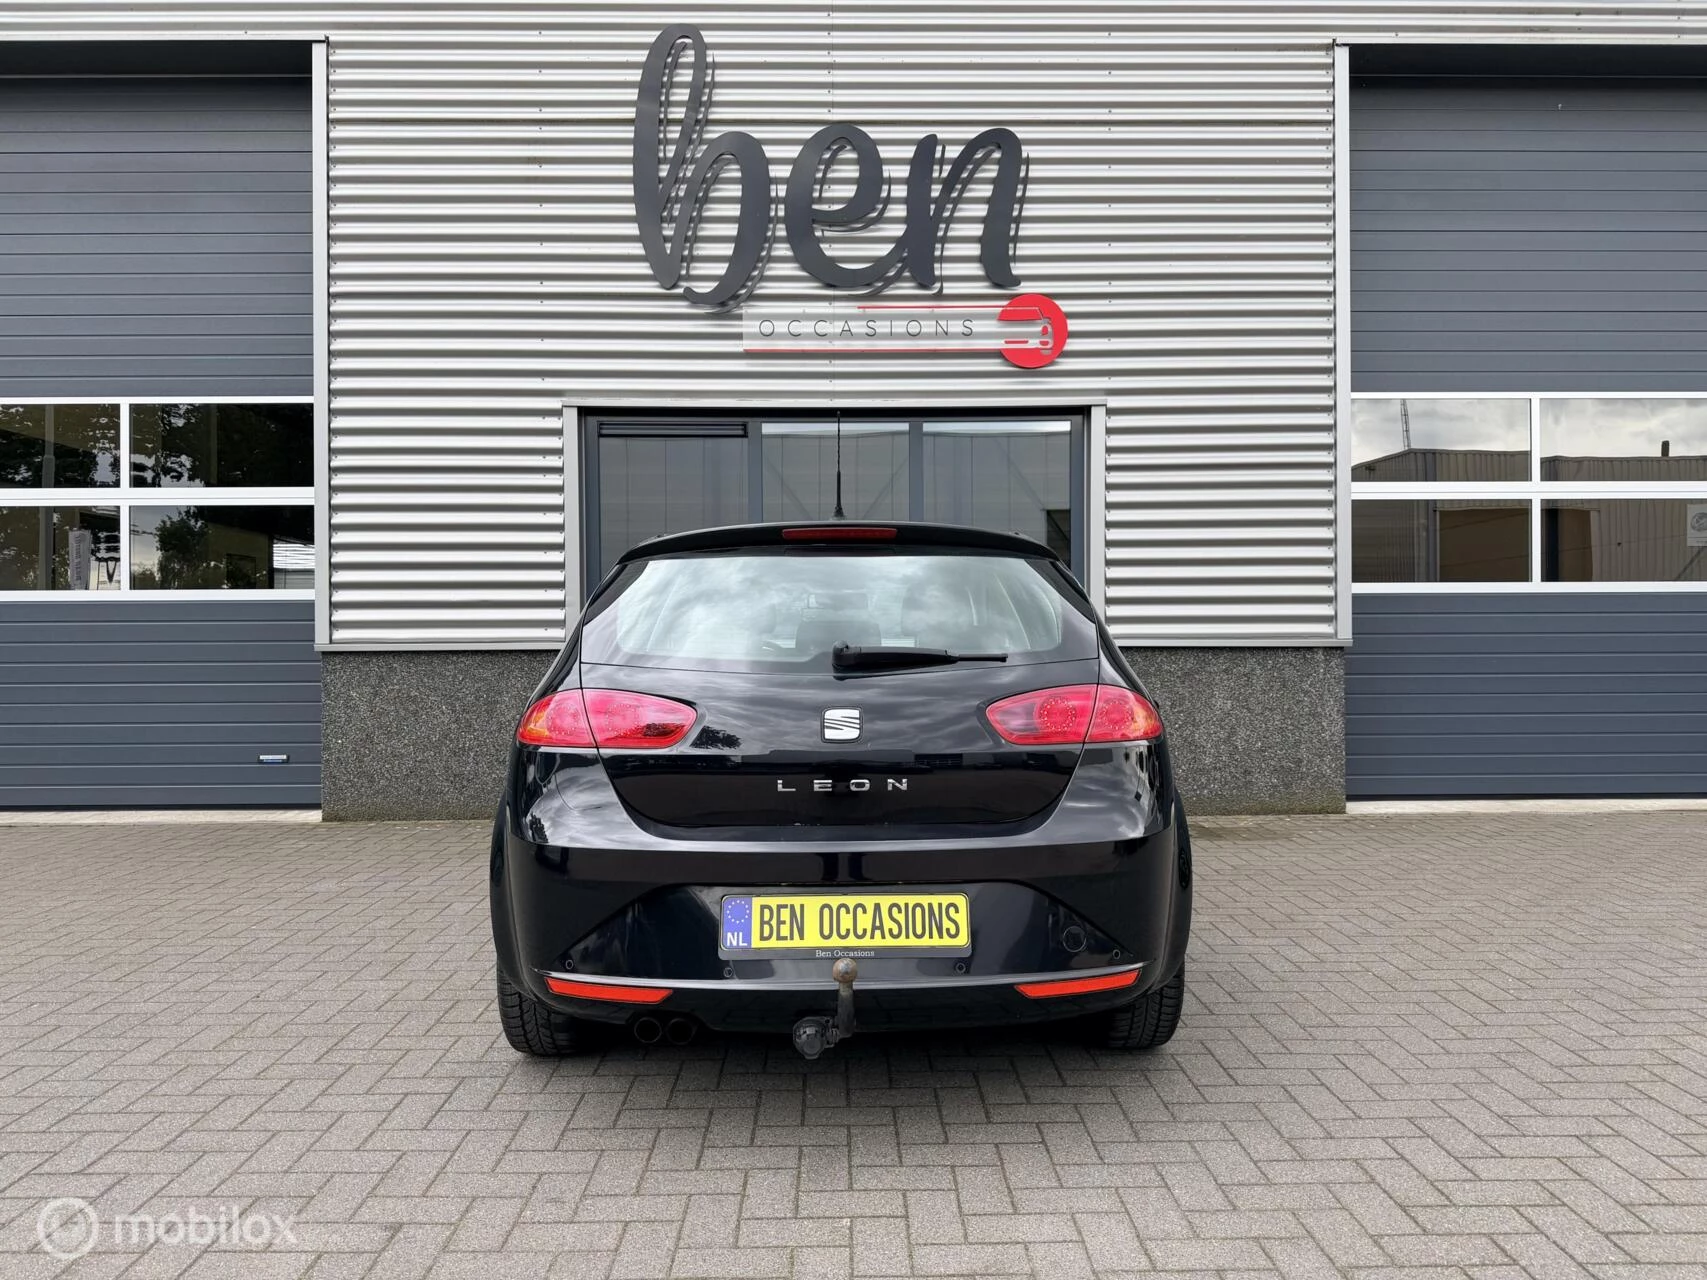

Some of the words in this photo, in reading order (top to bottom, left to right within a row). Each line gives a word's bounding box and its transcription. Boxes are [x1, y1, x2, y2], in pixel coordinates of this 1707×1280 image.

[633, 24, 1022, 305] ben
[759, 318, 976, 337] OCCASIONS
[777, 778, 908, 792] LEON
[760, 903, 805, 941] BEN
[819, 902, 961, 940] OCCASIONS
[727, 932, 748, 947] NL
[815, 950, 832, 958] Ben
[834, 950, 875, 958] Occasions
